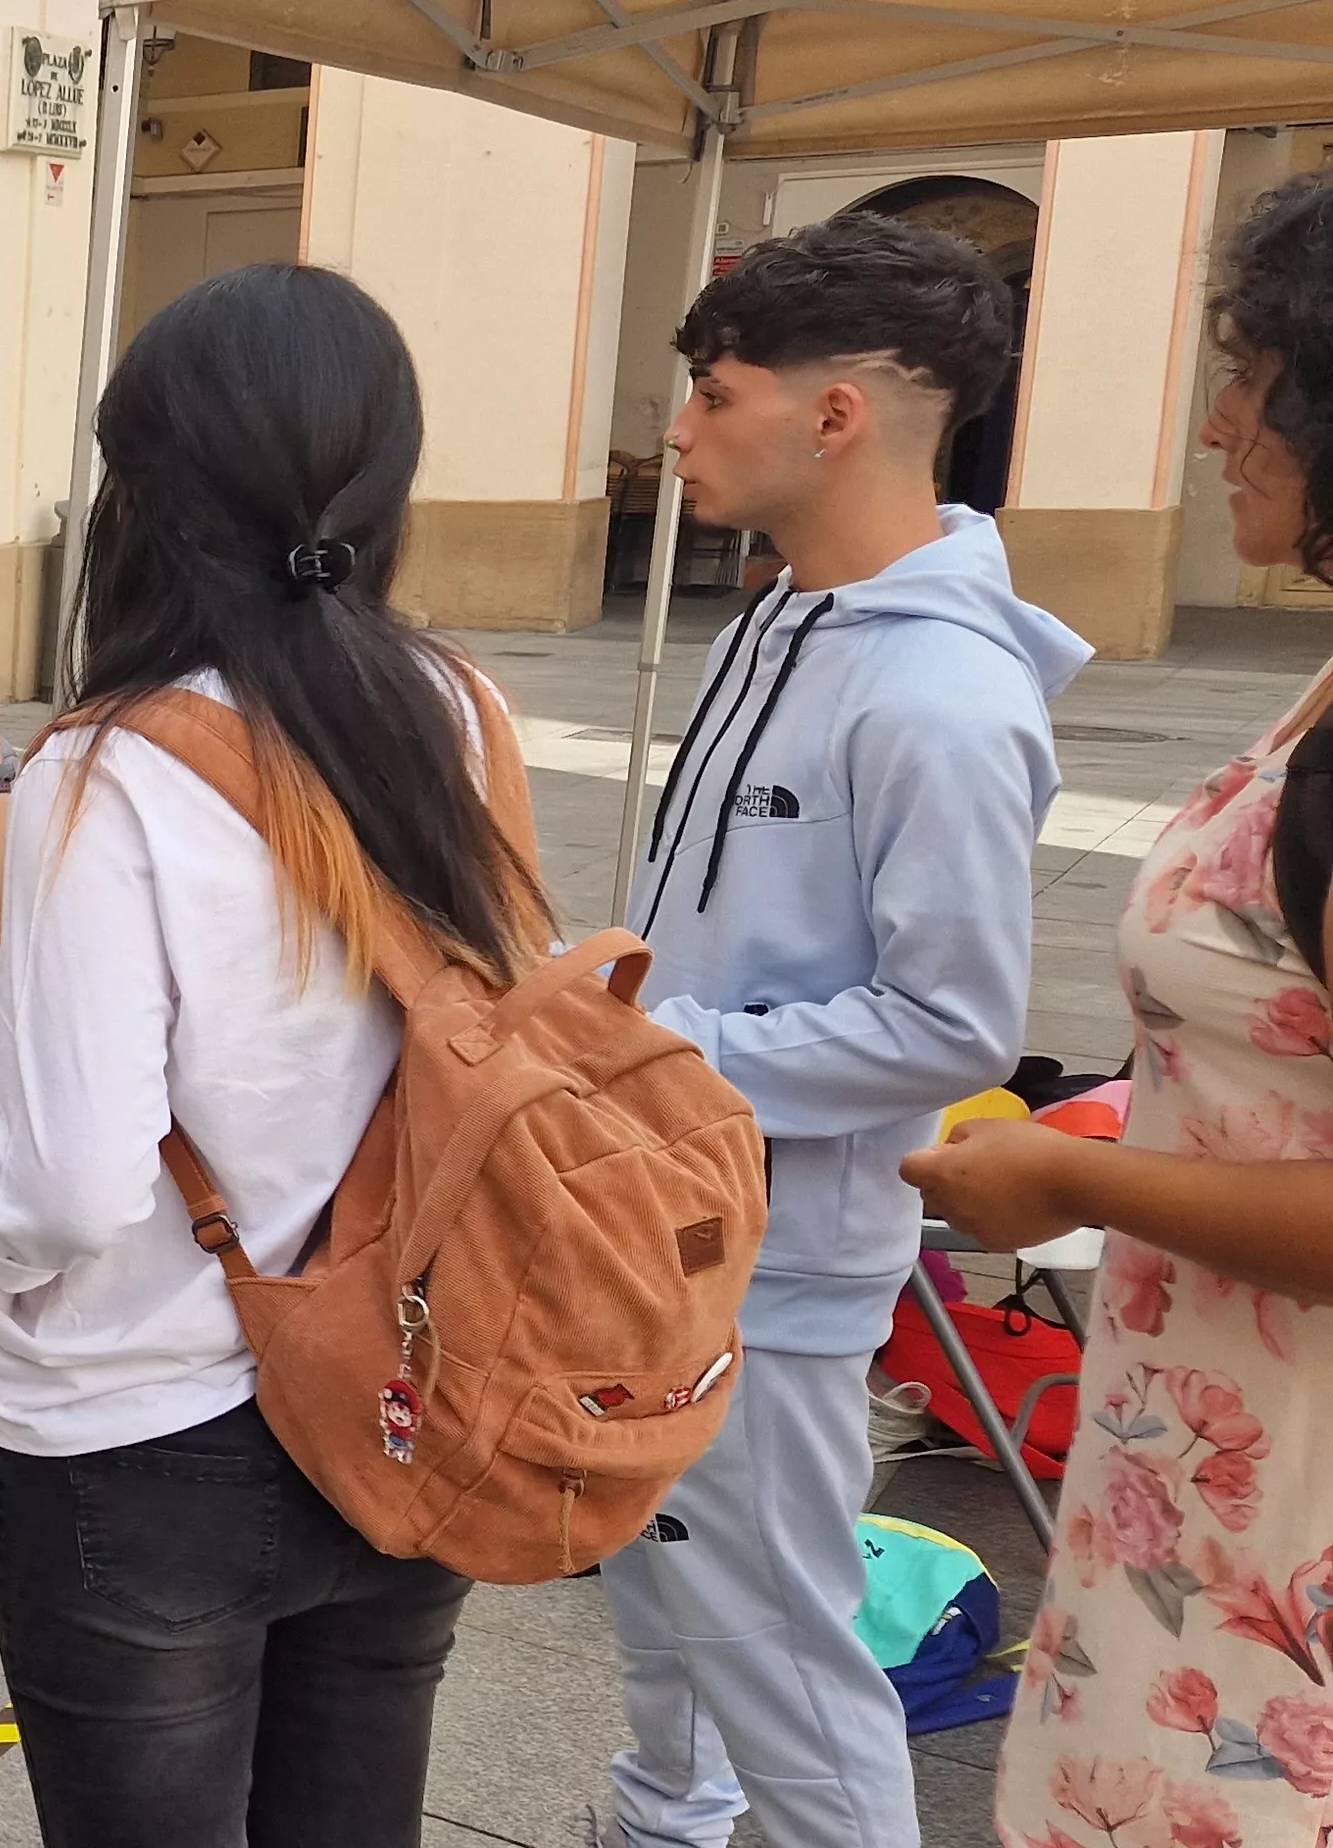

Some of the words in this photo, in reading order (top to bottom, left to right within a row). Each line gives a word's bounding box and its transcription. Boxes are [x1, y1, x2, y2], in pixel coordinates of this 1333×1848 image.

[42, 53, 68, 69] PLAZA
[734, 795, 770, 806] ORTH
[735, 806, 768, 818] FACE
